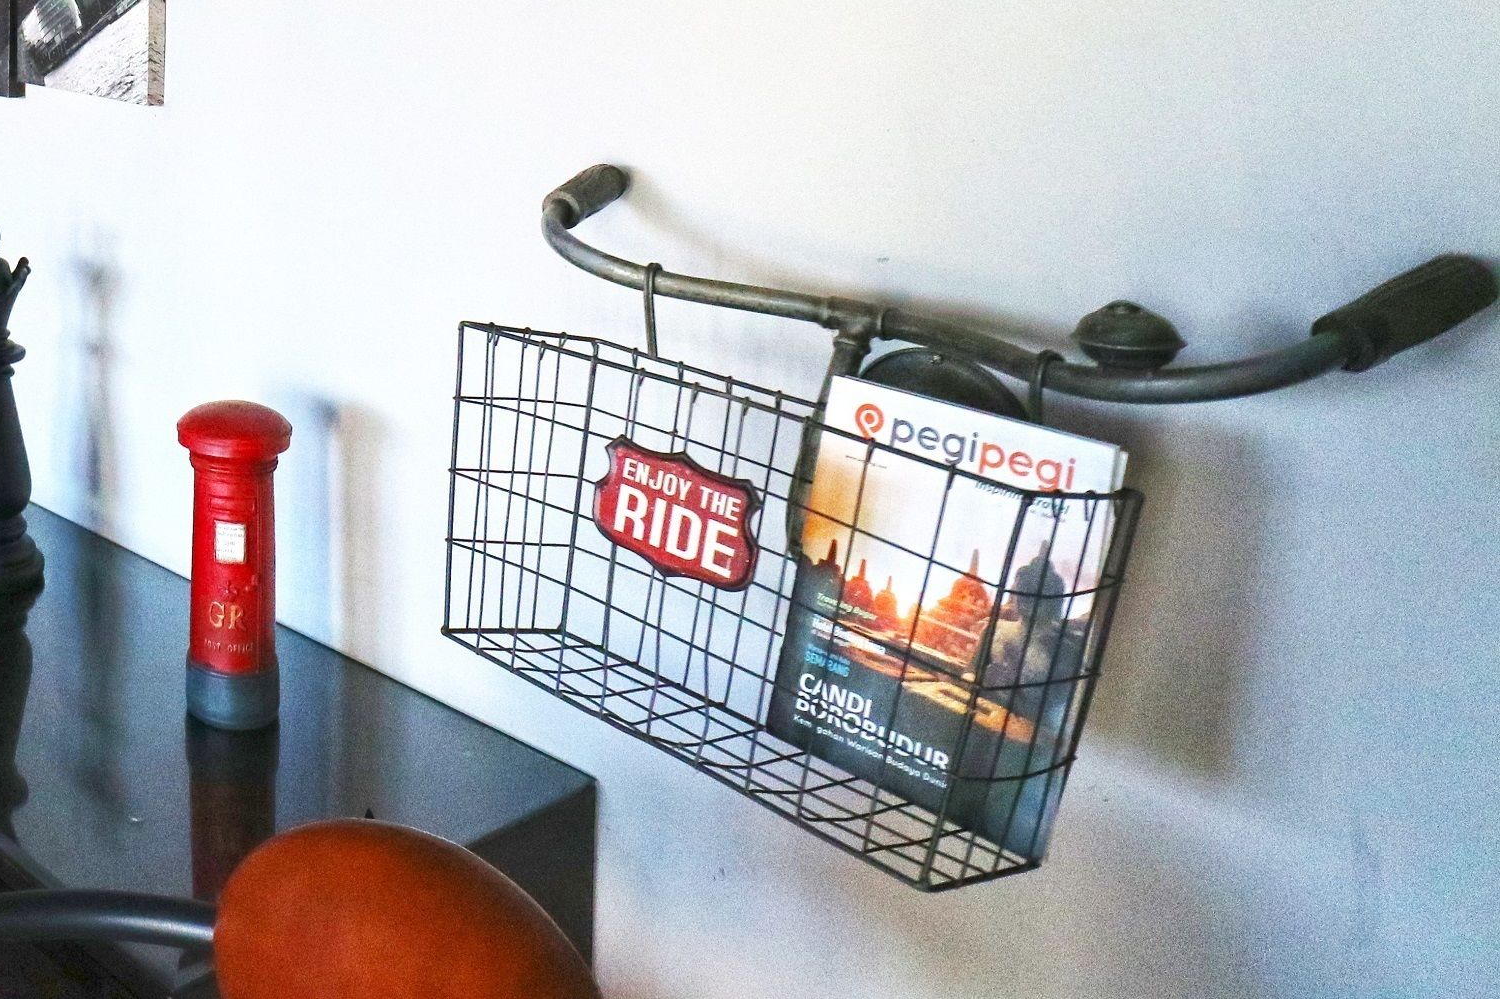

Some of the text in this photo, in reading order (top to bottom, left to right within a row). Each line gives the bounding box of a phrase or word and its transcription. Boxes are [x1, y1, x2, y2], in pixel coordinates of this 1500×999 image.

[890, 417, 1077, 492] pegipegi
[623, 457, 741, 522] ENJOY THE
[613, 483, 739, 579] RIDE
[209, 601, 247, 630] GR
[800, 673, 872, 718] CANDI
[793, 714, 844, 742] Kemgahan
